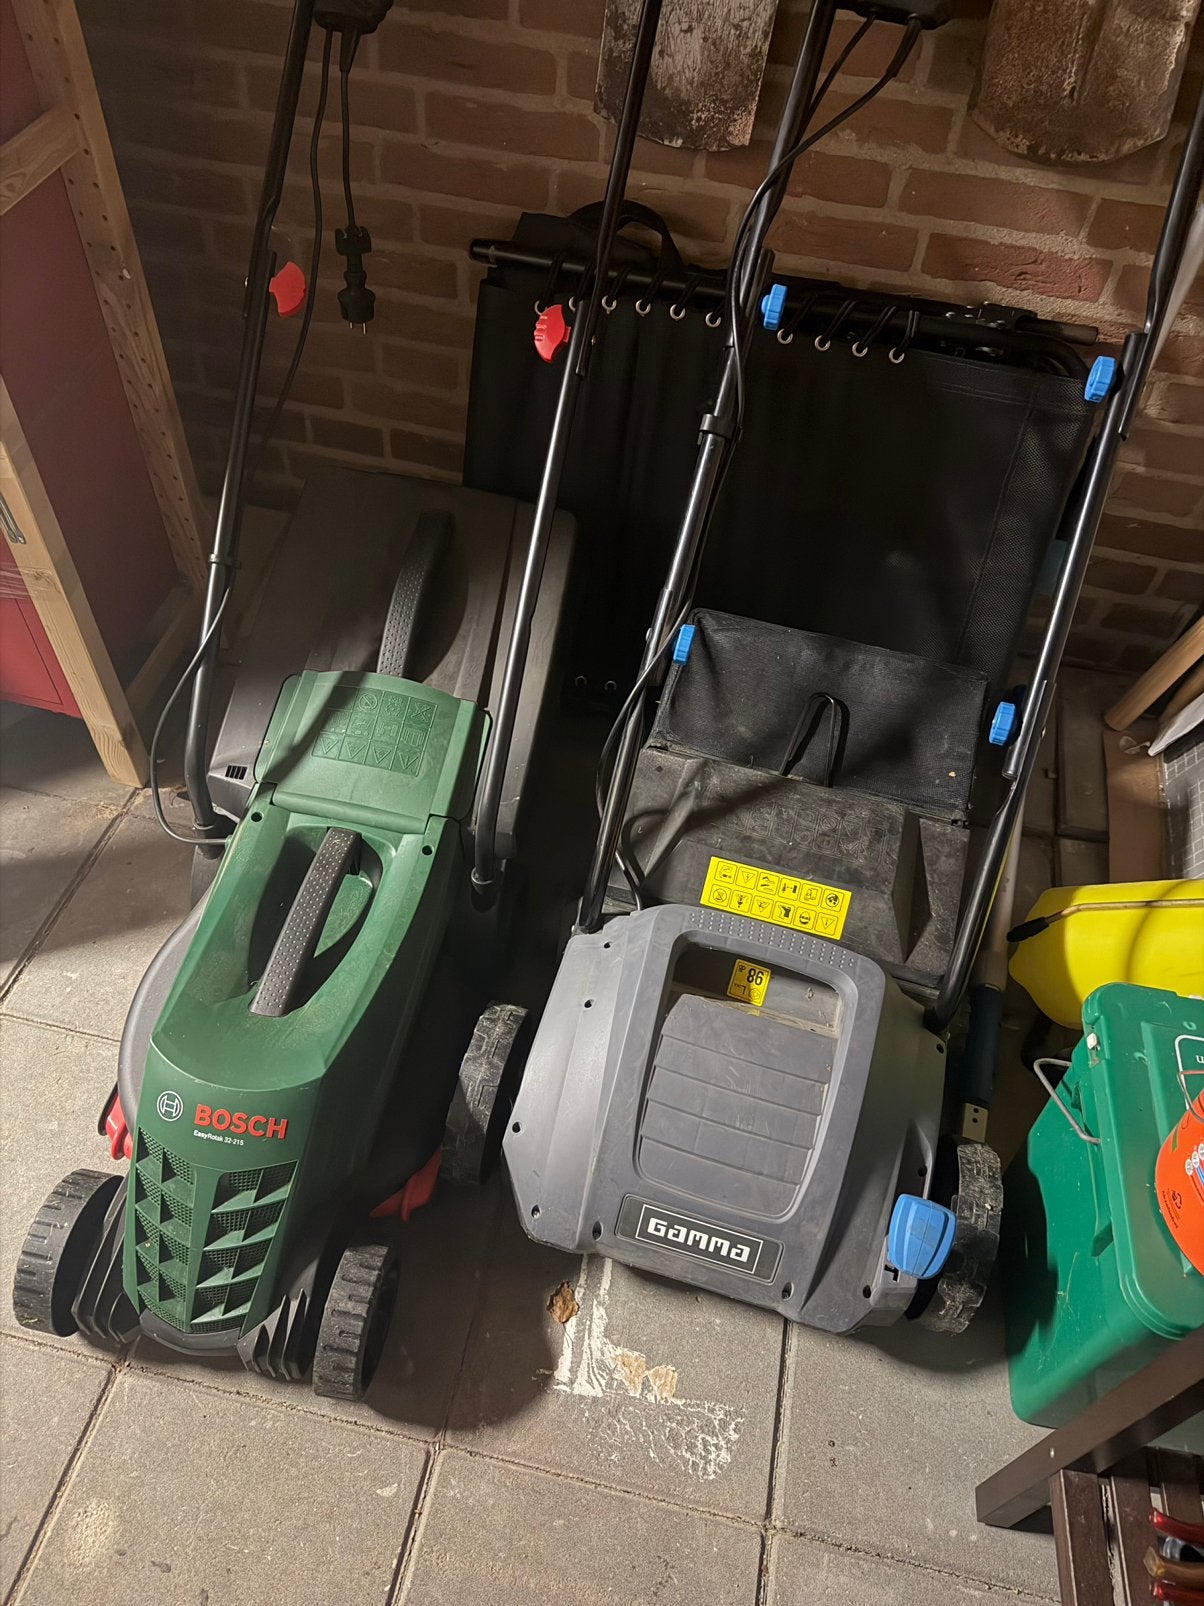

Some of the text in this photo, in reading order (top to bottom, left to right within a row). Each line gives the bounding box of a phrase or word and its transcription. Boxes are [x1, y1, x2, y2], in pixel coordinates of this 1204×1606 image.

[194, 1103, 288, 1139] BOSCH
[193, 1129, 245, 1146] EasyRotak 32-215
